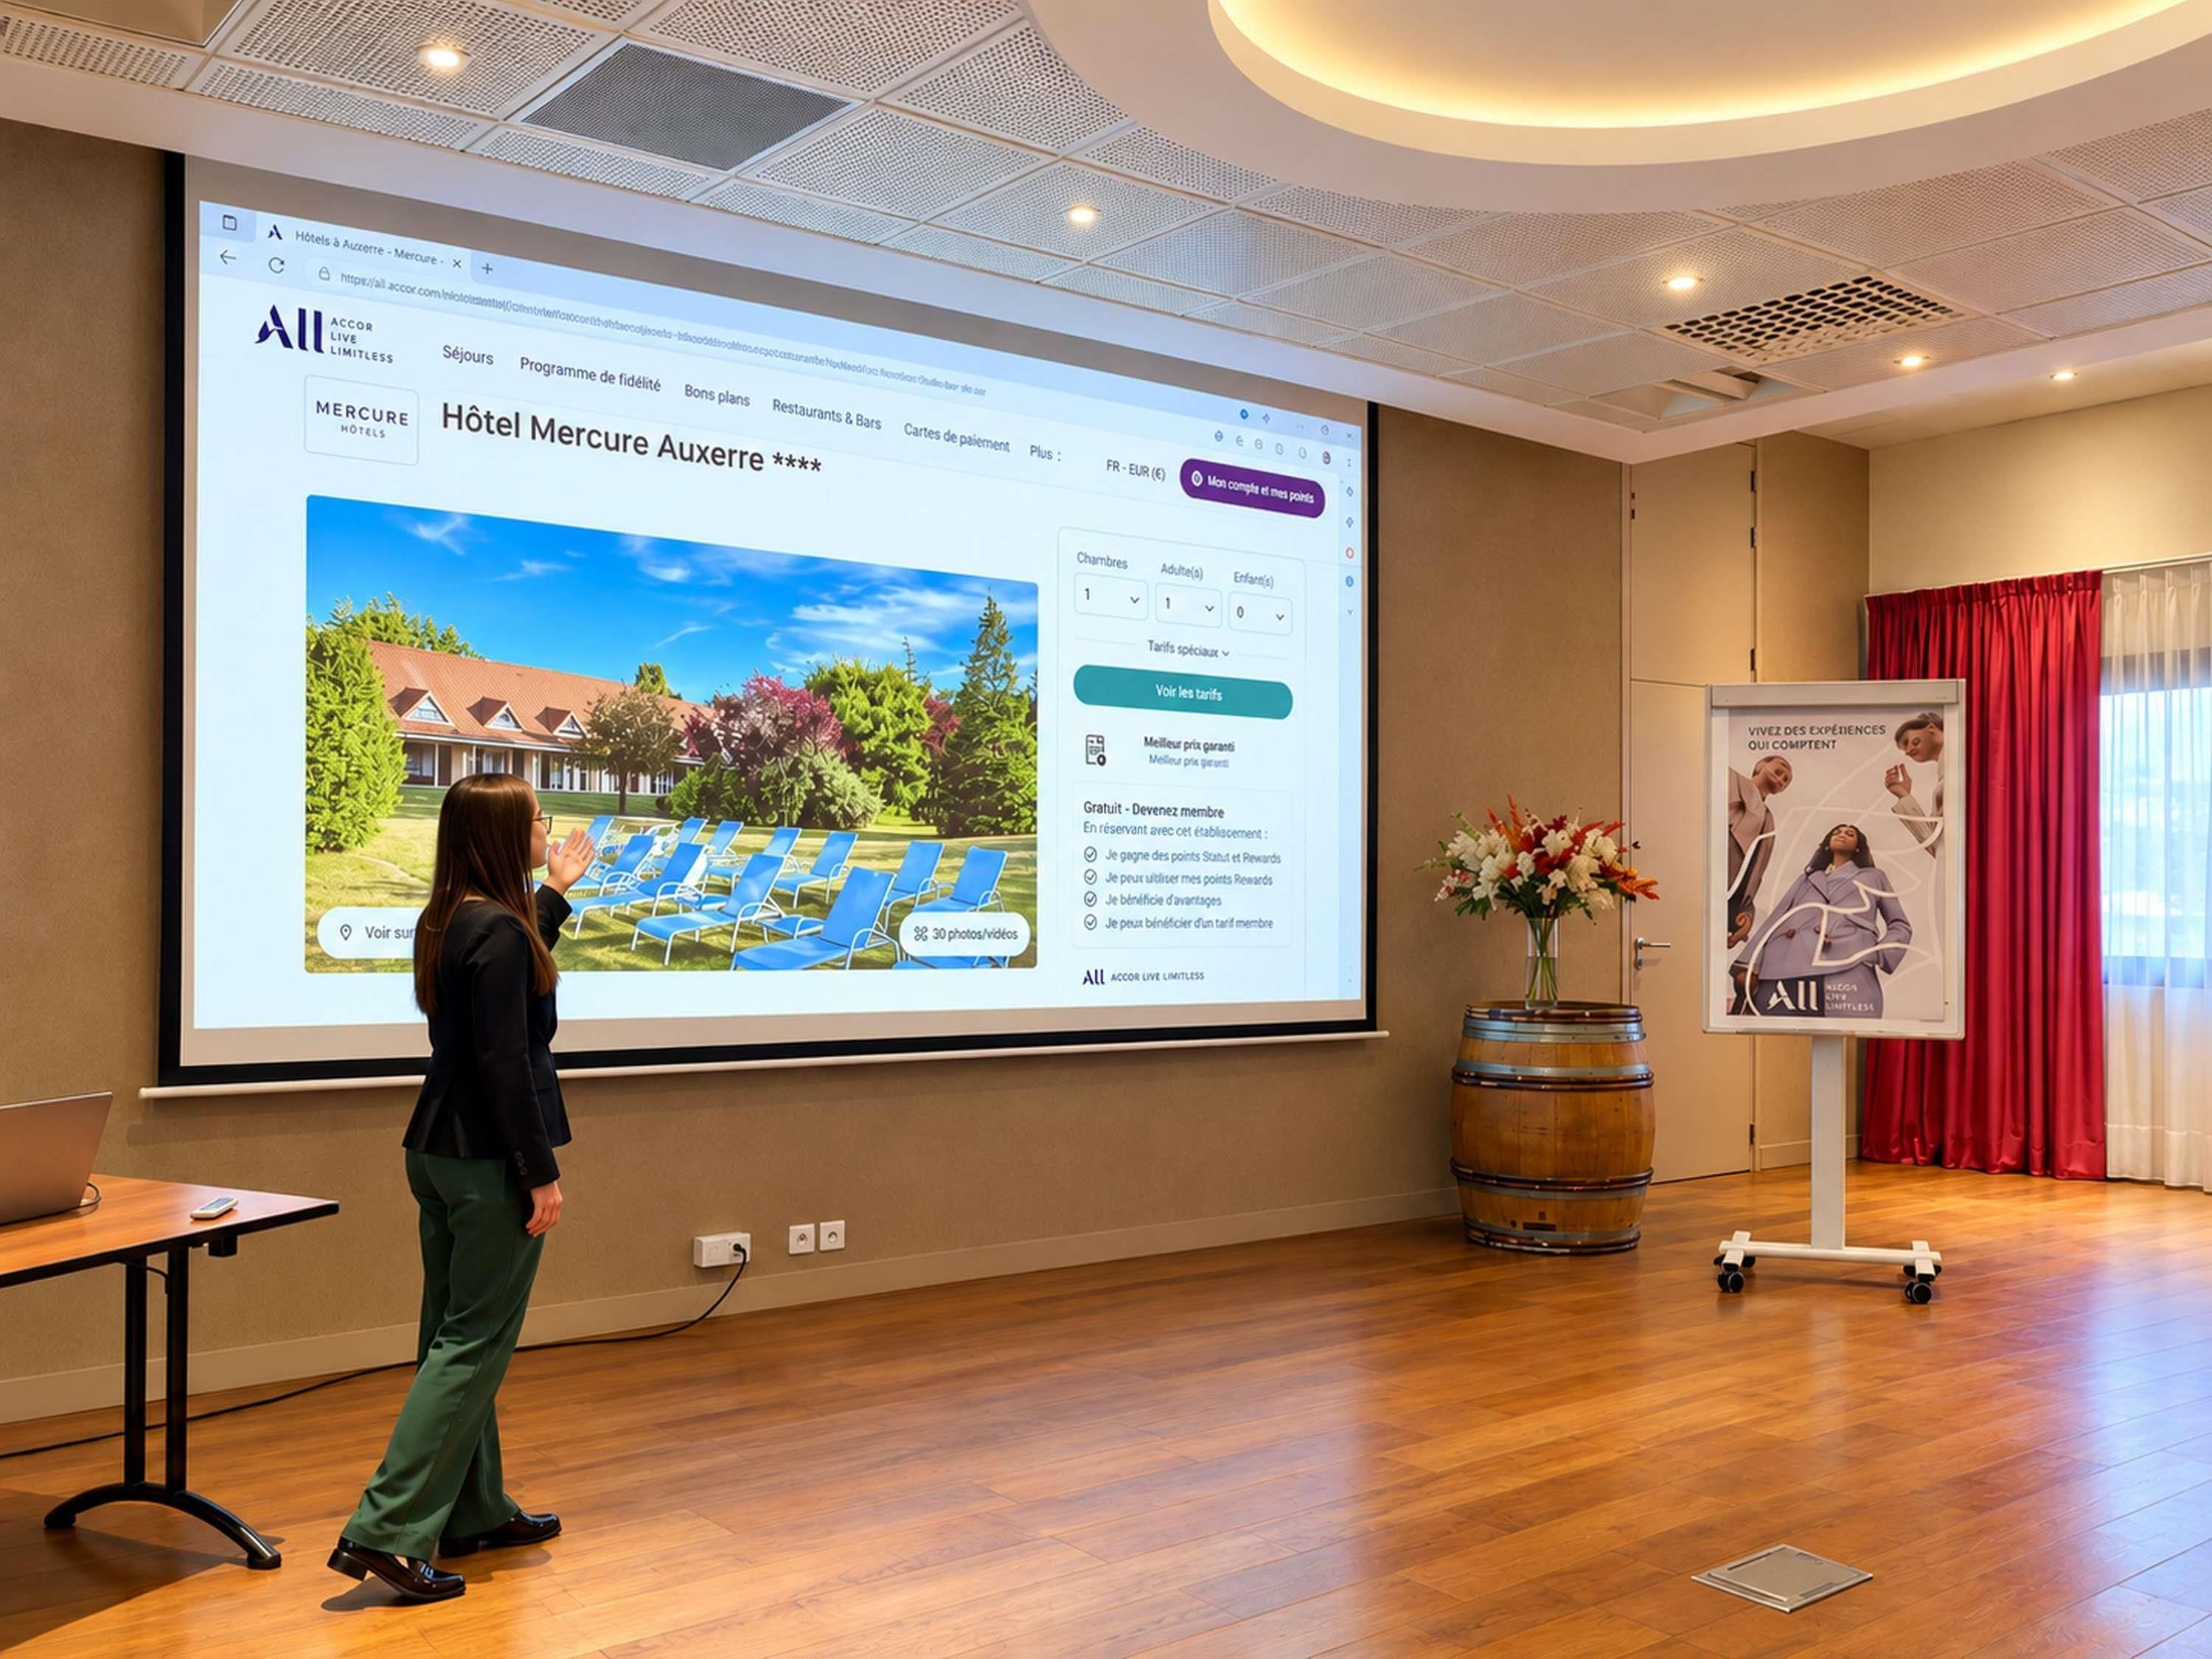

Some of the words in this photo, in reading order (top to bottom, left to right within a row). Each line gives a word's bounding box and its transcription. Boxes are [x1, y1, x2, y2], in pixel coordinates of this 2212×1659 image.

[295, 231, 330, 246] Hôtels
[333, 237, 341, 248] à
[394, 248, 437, 265] Mercure
[255, 305, 324, 354] All
[330, 318, 373, 332] ACCOR
[330, 332, 357, 344] LIVE
[330, 347, 394, 364] LIMITLESS
[442, 345, 495, 366] Séjours
[520, 357, 597, 381] Programme
[600, 370, 616, 383] de
[619, 373, 661, 392] fidélité
[684, 384, 715, 401] Bons
[718, 390, 751, 407] plans
[316, 400, 408, 426] MERCURE
[773, 398, 842, 423] Restaurants
[845, 412, 853, 425] &
[856, 414, 882, 431] Bars
[442, 403, 520, 438] Hôtel
[531, 415, 649, 455] Mercure
[657, 434, 764, 470] Auxerre
[904, 422, 941, 440] Cartes
[944, 430, 957, 444] de
[959, 434, 1010, 453] paiement
[1030, 445, 1053, 460] Plus
[1107, 459, 1120, 473] FR
[1129, 463, 1150, 478] EUR
[1151, 466, 1166, 482] (€)
[1208, 475, 1227, 489] Mon
[1228, 481, 1259, 496] compte
[1077, 552, 1128, 569] Chambres
[1161, 563, 1203, 581] Adulte(s)
[1234, 571, 1274, 589] Enfant(s)
[1085, 588, 1091, 600] 1
[1166, 597, 1171, 609] 1
[1237, 605, 1244, 618] 0
[1148, 640, 1175, 654] Tarifs
[1178, 644, 1218, 658] spéciaux
[1156, 685, 1176, 697] Voir
[1179, 686, 1194, 699] les
[1196, 687, 1222, 701] tarifs
[1748, 726, 1781, 736] VIVEZ
[1784, 726, 1806, 736] DES
[1183, 739, 1201, 752] prix
[1748, 740, 1769, 751] QUI
[1084, 801, 1121, 815] Gratuit
[1133, 803, 1178, 817] Devenez
[1180, 806, 1225, 818] membre
[1084, 821, 1097, 833] En
[1099, 822, 1147, 835] réservant
[1150, 826, 1175, 836] avec
[1176, 827, 1192, 837] cet
[1106, 850, 1118, 860] Je
[1120, 852, 1150, 863] gagne
[1152, 850, 1169, 861] des
[1171, 851, 1200, 863] points
[1232, 852, 1241, 863] et
[1242, 852, 1281, 863] Rewards
[1106, 872, 1118, 883] Je
[1181, 874, 1201, 884] mes
[1203, 874, 1232, 886] points
[1234, 874, 1273, 886] Rewards
[1106, 894, 1118, 905] Je
[1120, 893, 1164, 906] bénéficie
[1106, 917, 1118, 928] Je
[1145, 917, 1192, 929] bénéficier
[1194, 917, 1214, 928] d'un
[1215, 917, 1234, 928] tarif
[1236, 918, 1274, 929] membre
[364, 926, 391, 939] Voir
[394, 928, 415, 939] sur
[933, 928, 946, 940] 30
[948, 927, 1018, 942] photos/vidéos
[1082, 969, 1105, 985] All
[1111, 973, 1140, 981] ACCOR
[1143, 973, 1160, 981] LIVE
[1163, 972, 1205, 981] LIMITLESS
